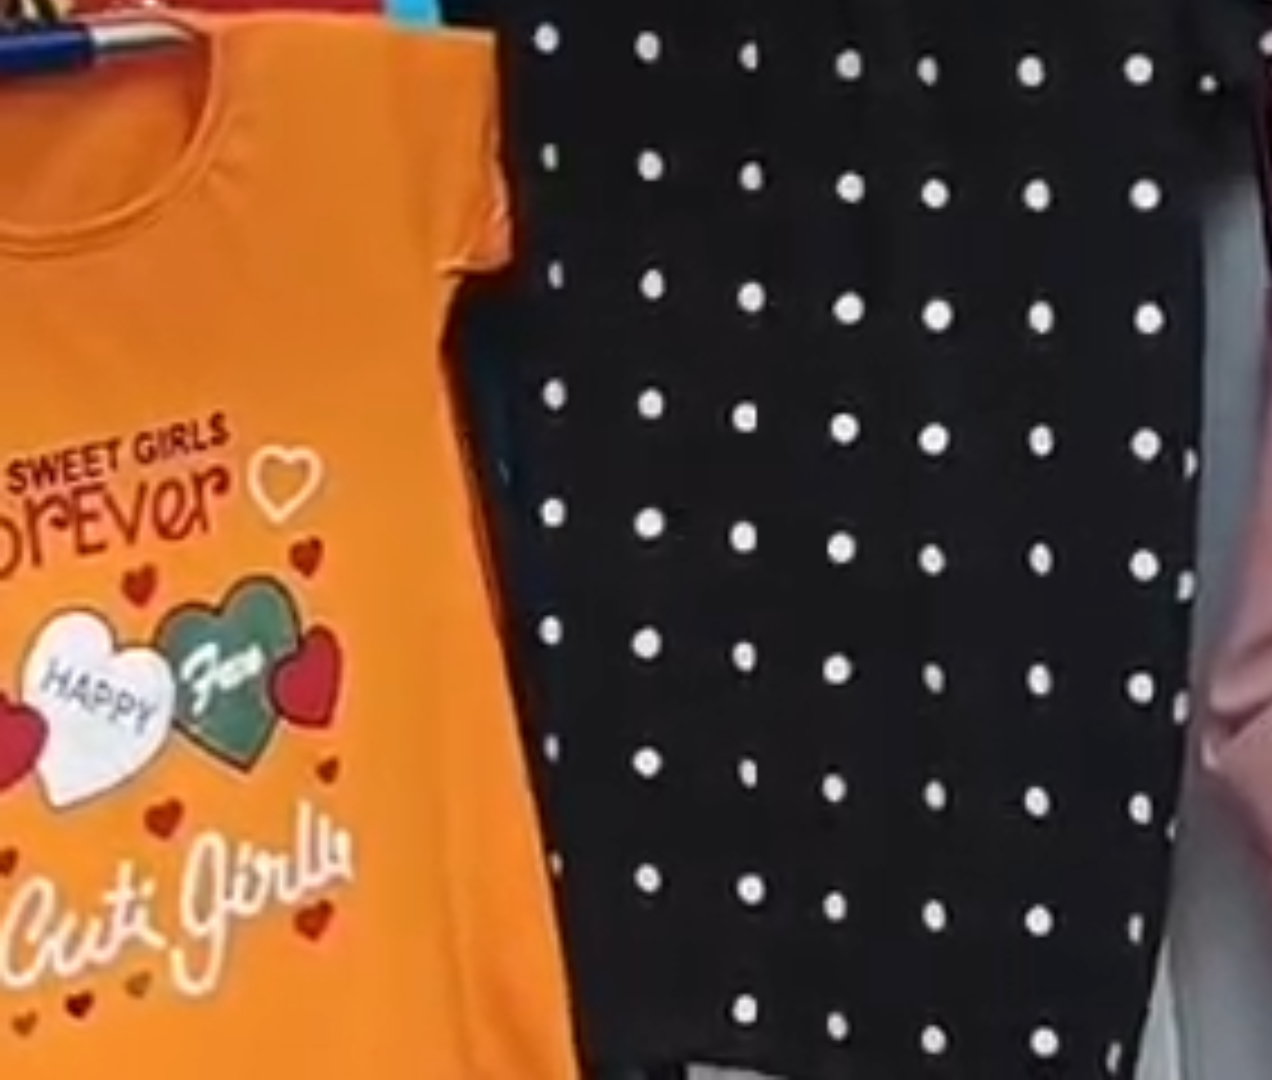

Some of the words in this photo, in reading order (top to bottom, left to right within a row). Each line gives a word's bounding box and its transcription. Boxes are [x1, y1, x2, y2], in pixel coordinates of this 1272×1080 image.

[7, 436, 121, 495] SWEET
[133, 411, 230, 464] GIRLS
[41, 658, 157, 734] HAPPY
